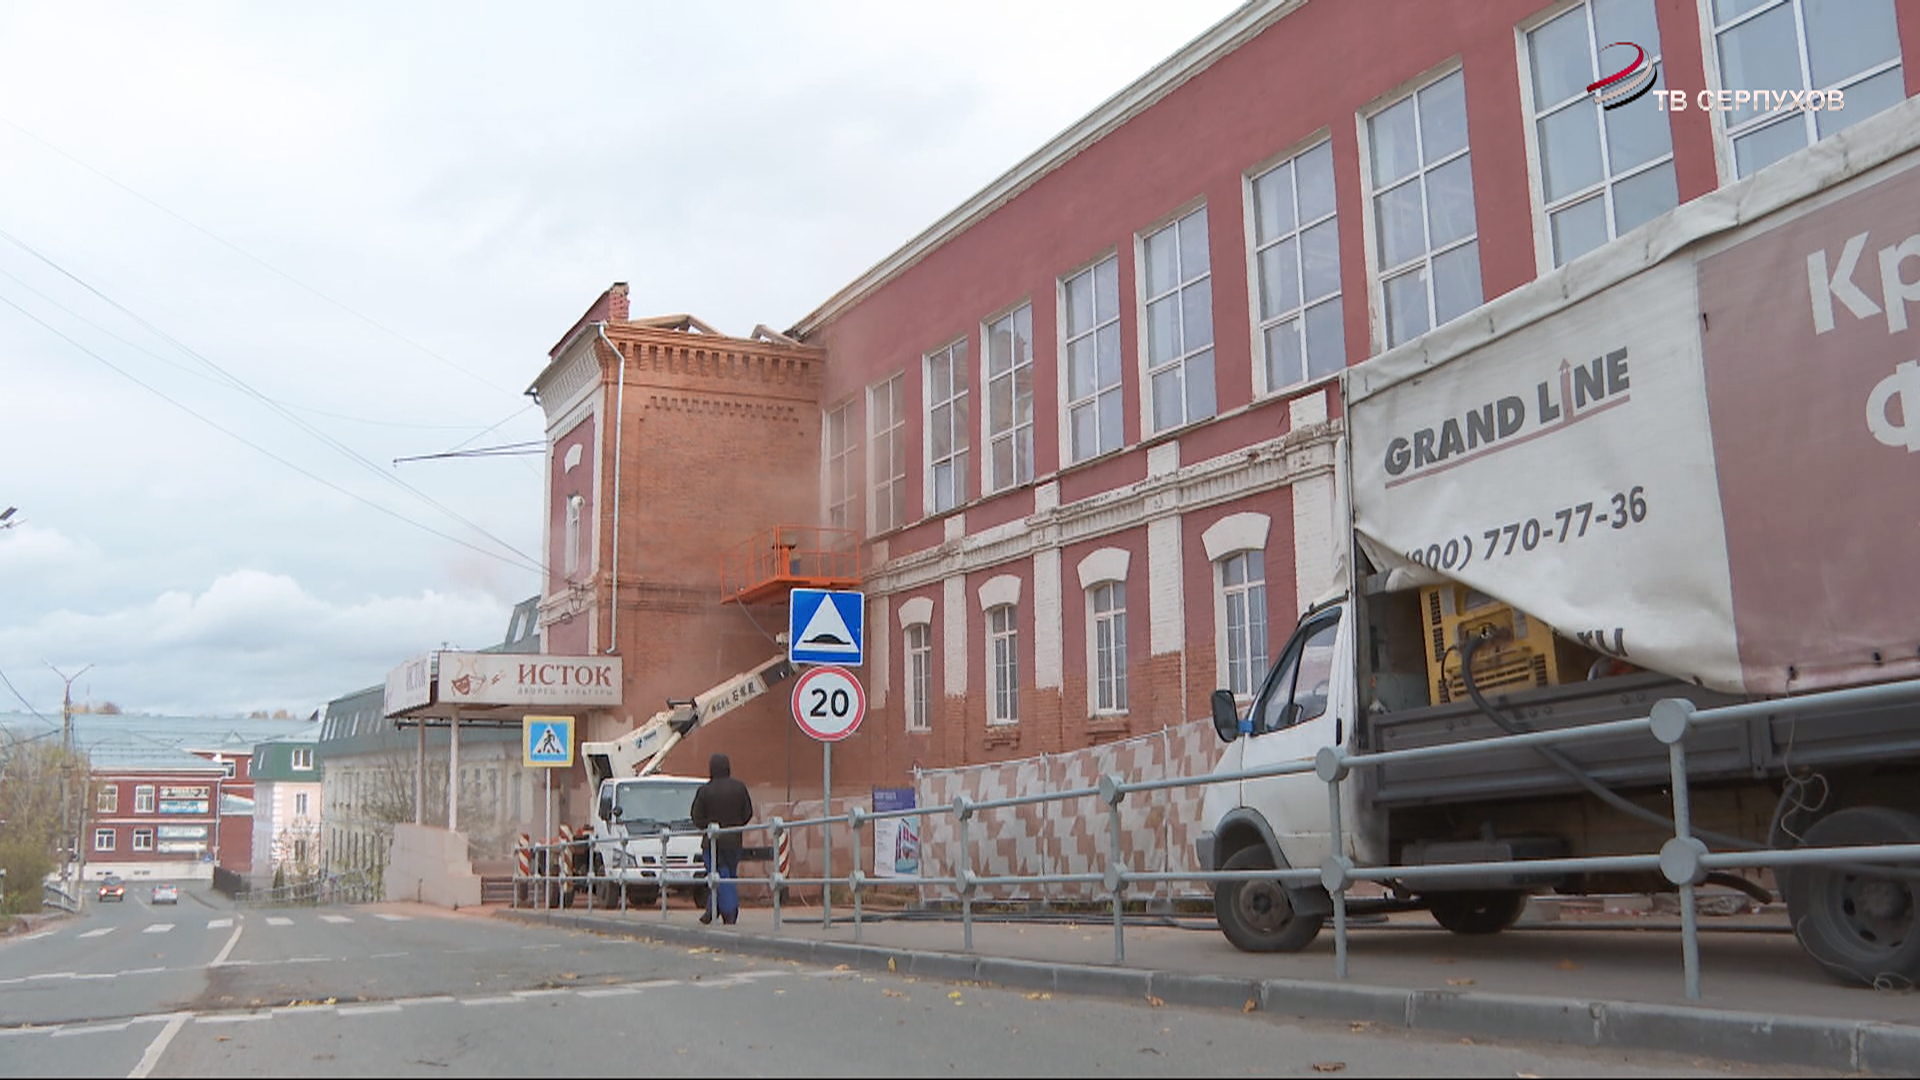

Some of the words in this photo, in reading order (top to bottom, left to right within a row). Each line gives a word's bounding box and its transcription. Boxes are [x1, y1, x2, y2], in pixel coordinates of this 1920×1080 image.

[1384, 395, 1526, 476] GRAND
[1537, 346, 1630, 424] LINE
[1483, 485, 1648, 561] 770-77-36
[518, 663, 612, 687] ИСТОК
[809, 688, 850, 718] 20
